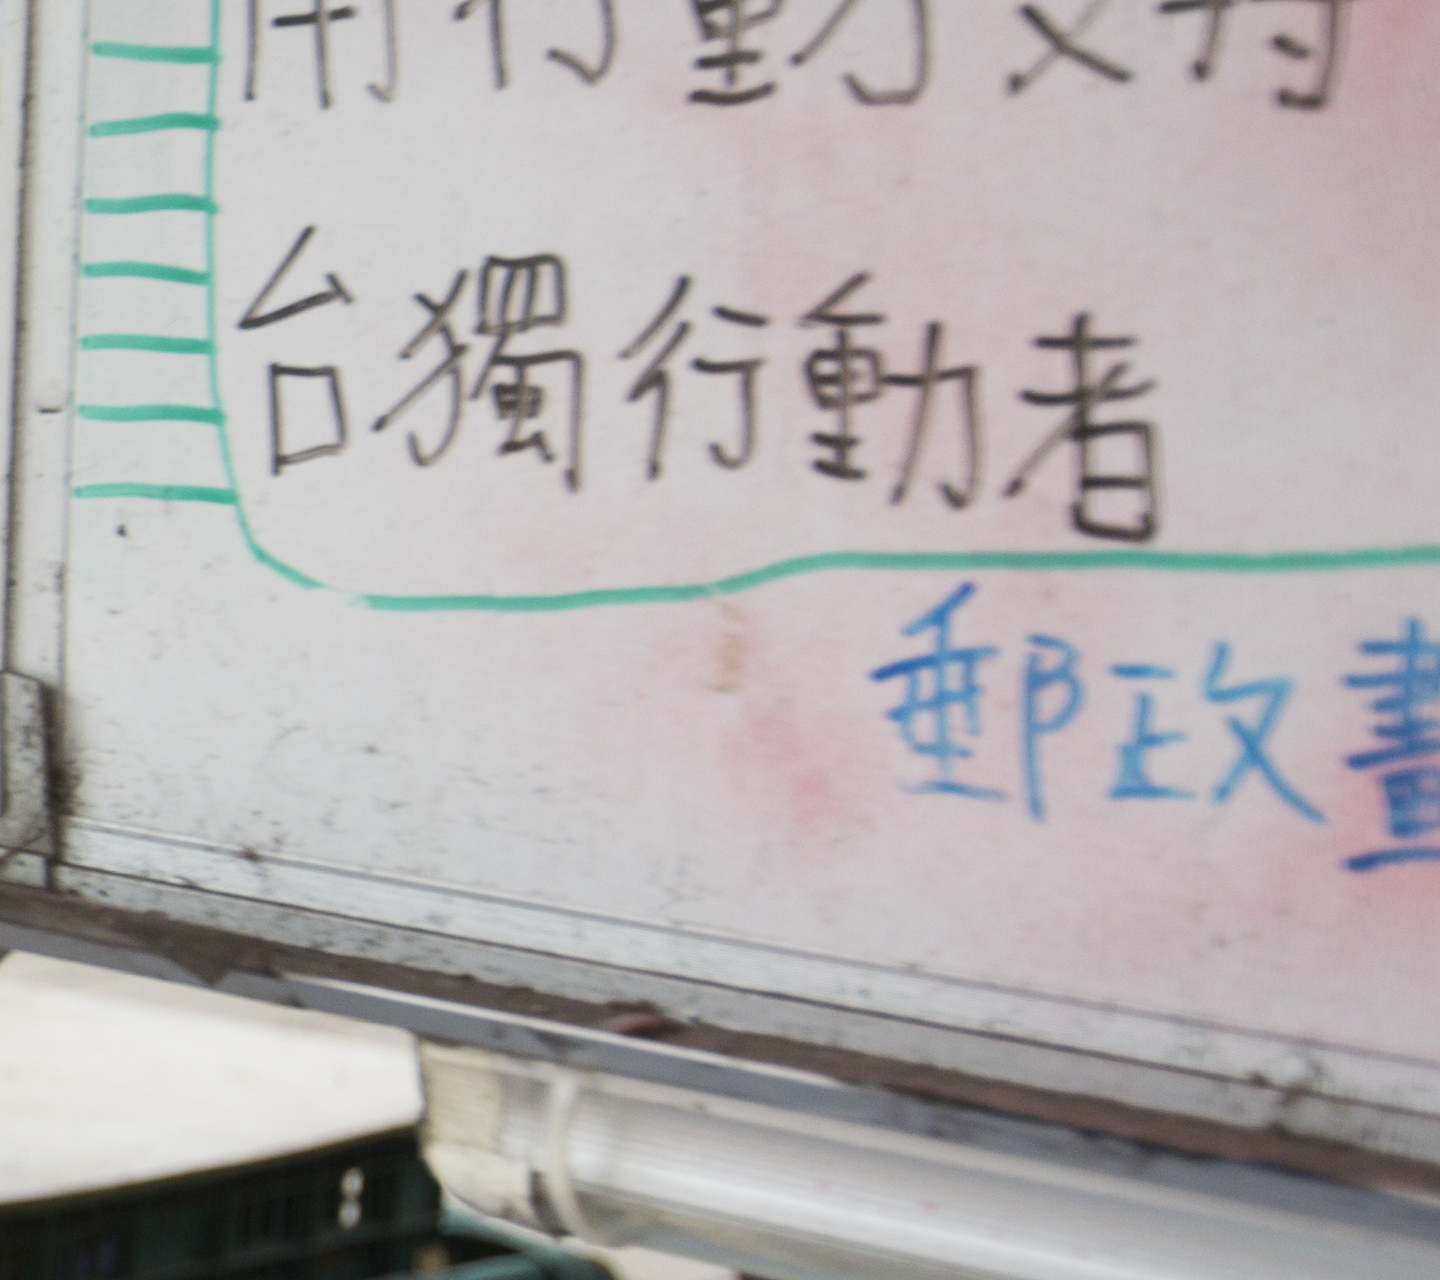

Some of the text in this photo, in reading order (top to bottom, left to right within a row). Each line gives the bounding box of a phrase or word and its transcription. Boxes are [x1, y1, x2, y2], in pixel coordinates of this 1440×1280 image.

[237, 224, 1160, 544] 台獨行動者
